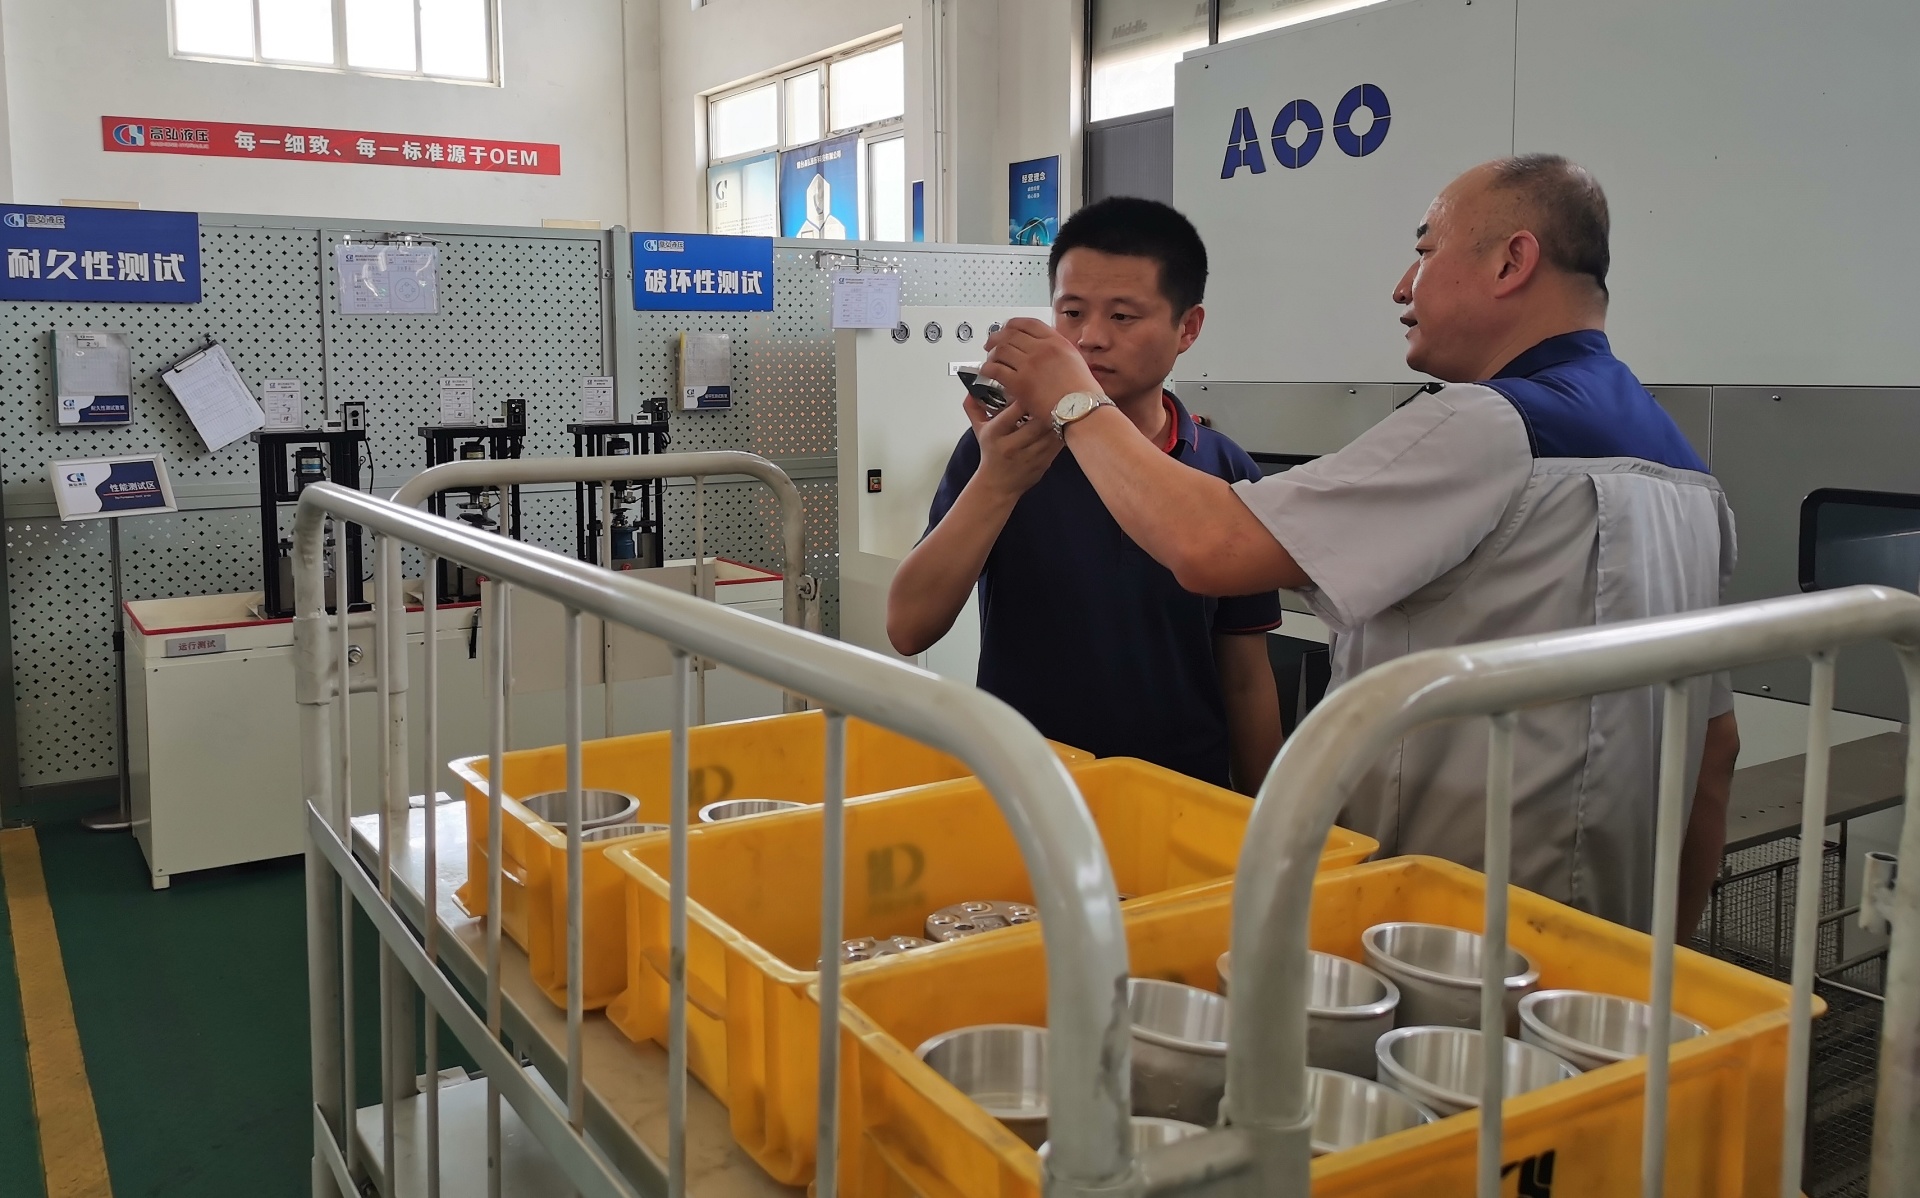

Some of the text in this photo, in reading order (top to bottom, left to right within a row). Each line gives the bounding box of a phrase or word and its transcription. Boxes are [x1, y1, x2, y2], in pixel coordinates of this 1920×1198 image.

[1111, 18, 1148, 40] Middle
[149, 126, 209, 142] 高弘液压
[234, 130, 538, 167] 每一细致、每一标准源于OEM
[1021, 171, 1046, 184] 经营理念
[7, 248, 186, 283] 耐久性测试
[644, 268, 763, 295] 破坏性测试
[109, 480, 156, 493] 性能测试区
[178, 640, 217, 652] 运行测试
